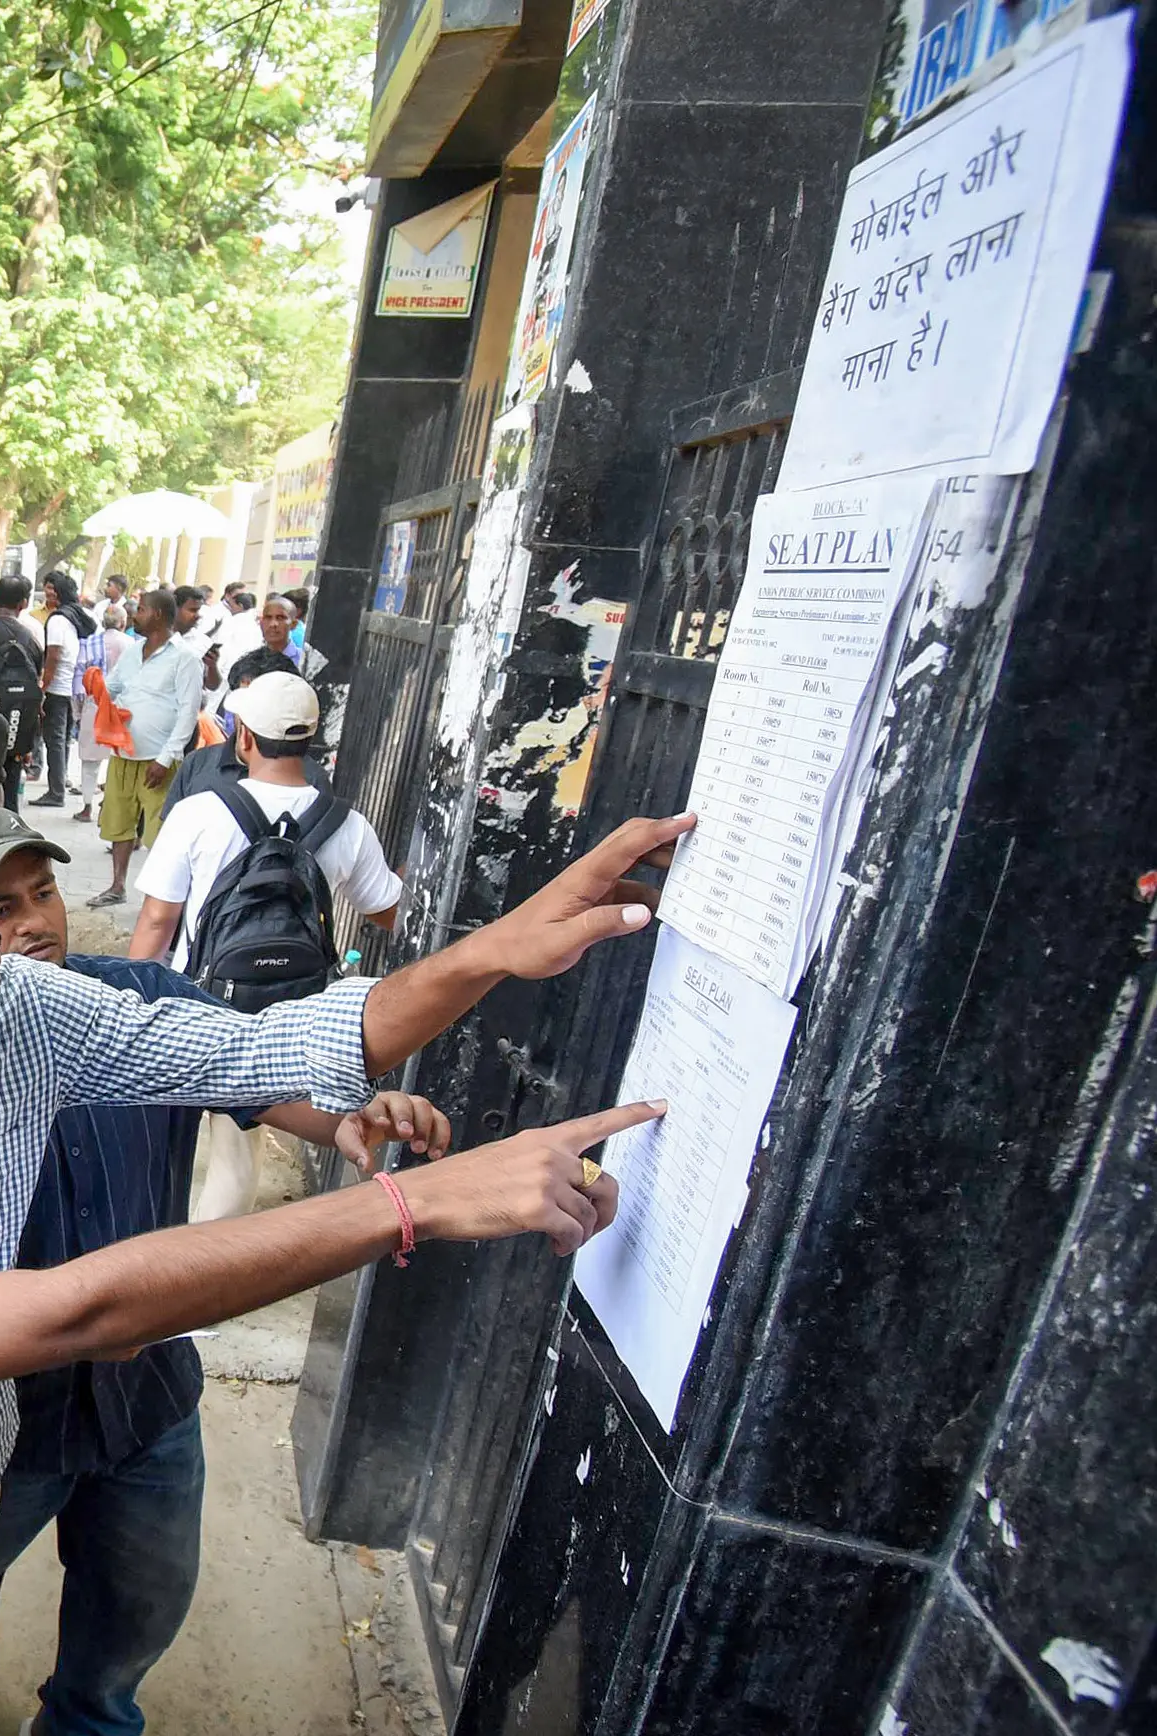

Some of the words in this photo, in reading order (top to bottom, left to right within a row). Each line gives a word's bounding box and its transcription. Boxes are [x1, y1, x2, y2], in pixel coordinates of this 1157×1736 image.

[961, 126, 1026, 194] और
[869, 254, 933, 310] अंदर
[946, 211, 1025, 281] लाना
[385, 296, 408, 308] VICE
[410, 296, 466, 309] PRESIDENT
[843, 340, 898, 391] माना
[766, 532, 828, 565] SEAT
[829, 527, 900, 564] PLAN
[723, 668, 746, 681] Room
[802, 679, 819, 693] Roll
[685, 966, 708, 991] SEAT
[708, 982, 733, 1011] PLAN
